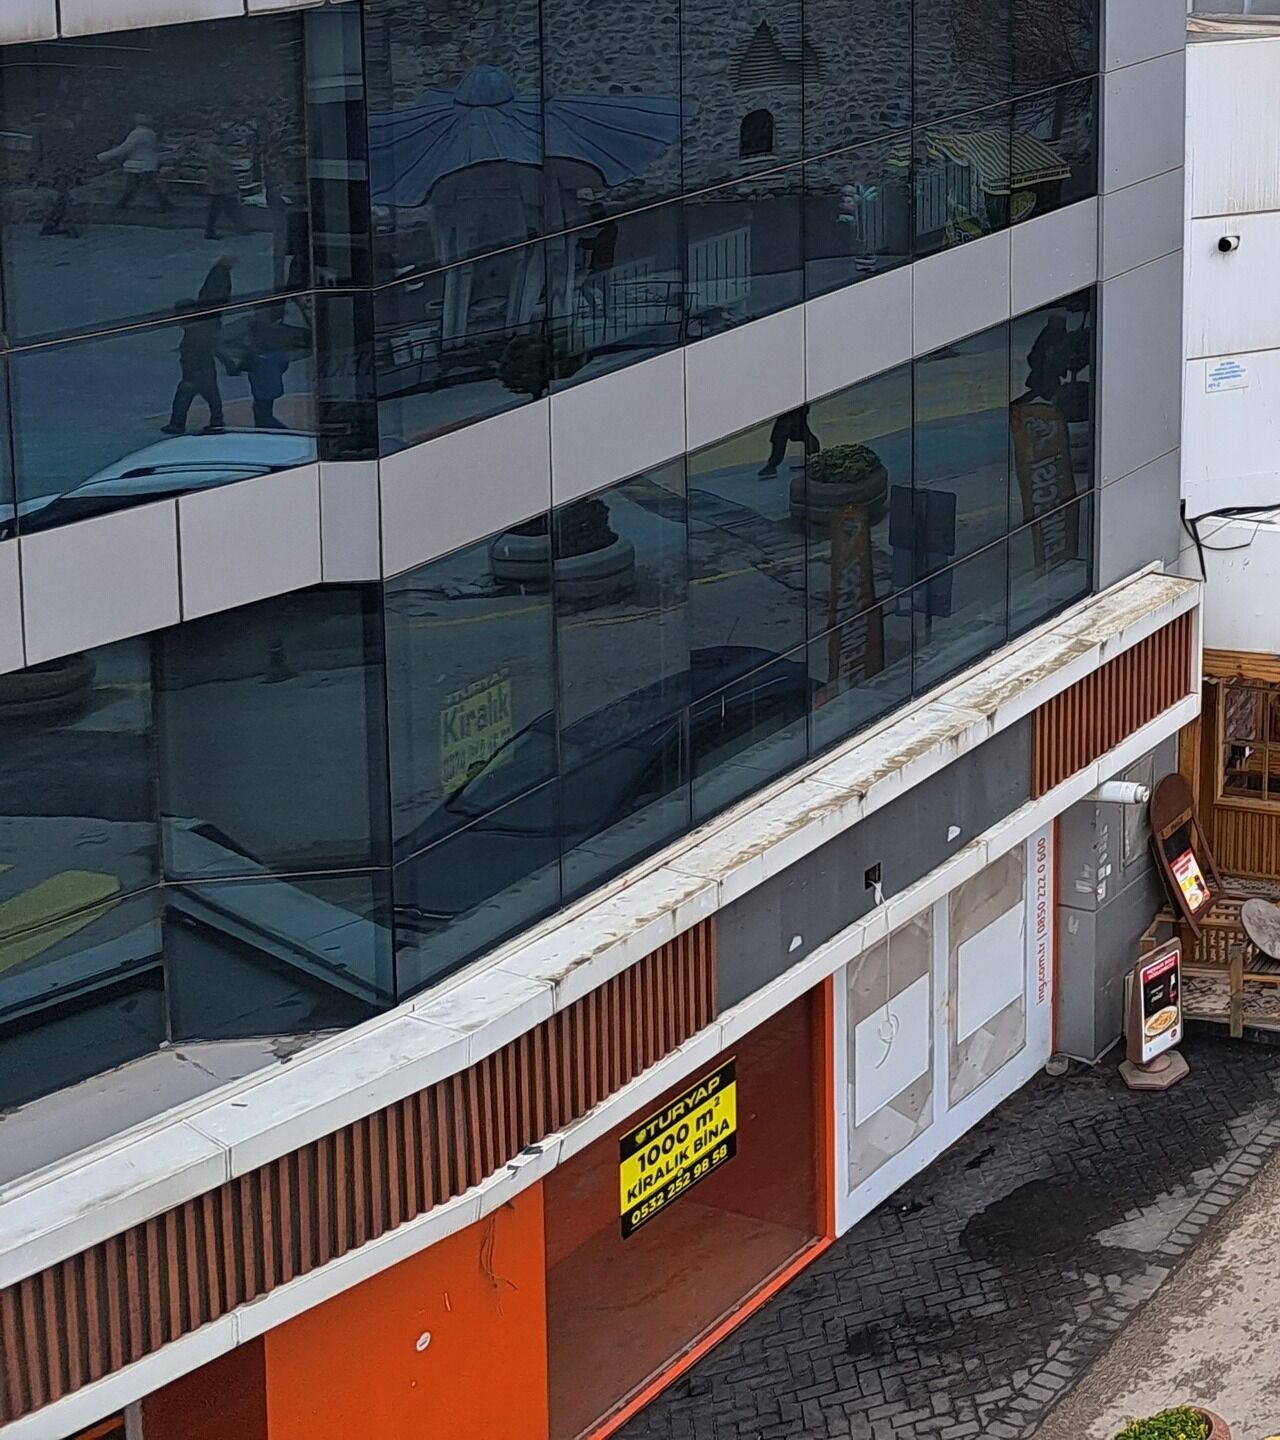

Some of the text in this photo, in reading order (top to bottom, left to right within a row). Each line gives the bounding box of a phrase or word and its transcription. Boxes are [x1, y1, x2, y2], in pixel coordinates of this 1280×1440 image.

[1037, 837, 1047, 863] 600
[1037, 864, 1046, 874] 0
[1037, 875, 1047, 901] 222
[1037, 901, 1047, 934] 0850
[1036, 944, 1047, 1006] ing.com.tr
[646, 1076, 720, 1138] TURYAP
[627, 1118, 730, 1205] KİRALIK BİNA
[637, 1123, 690, 1173] 1000
[631, 1144, 728, 1225] 0532 252 98 58
